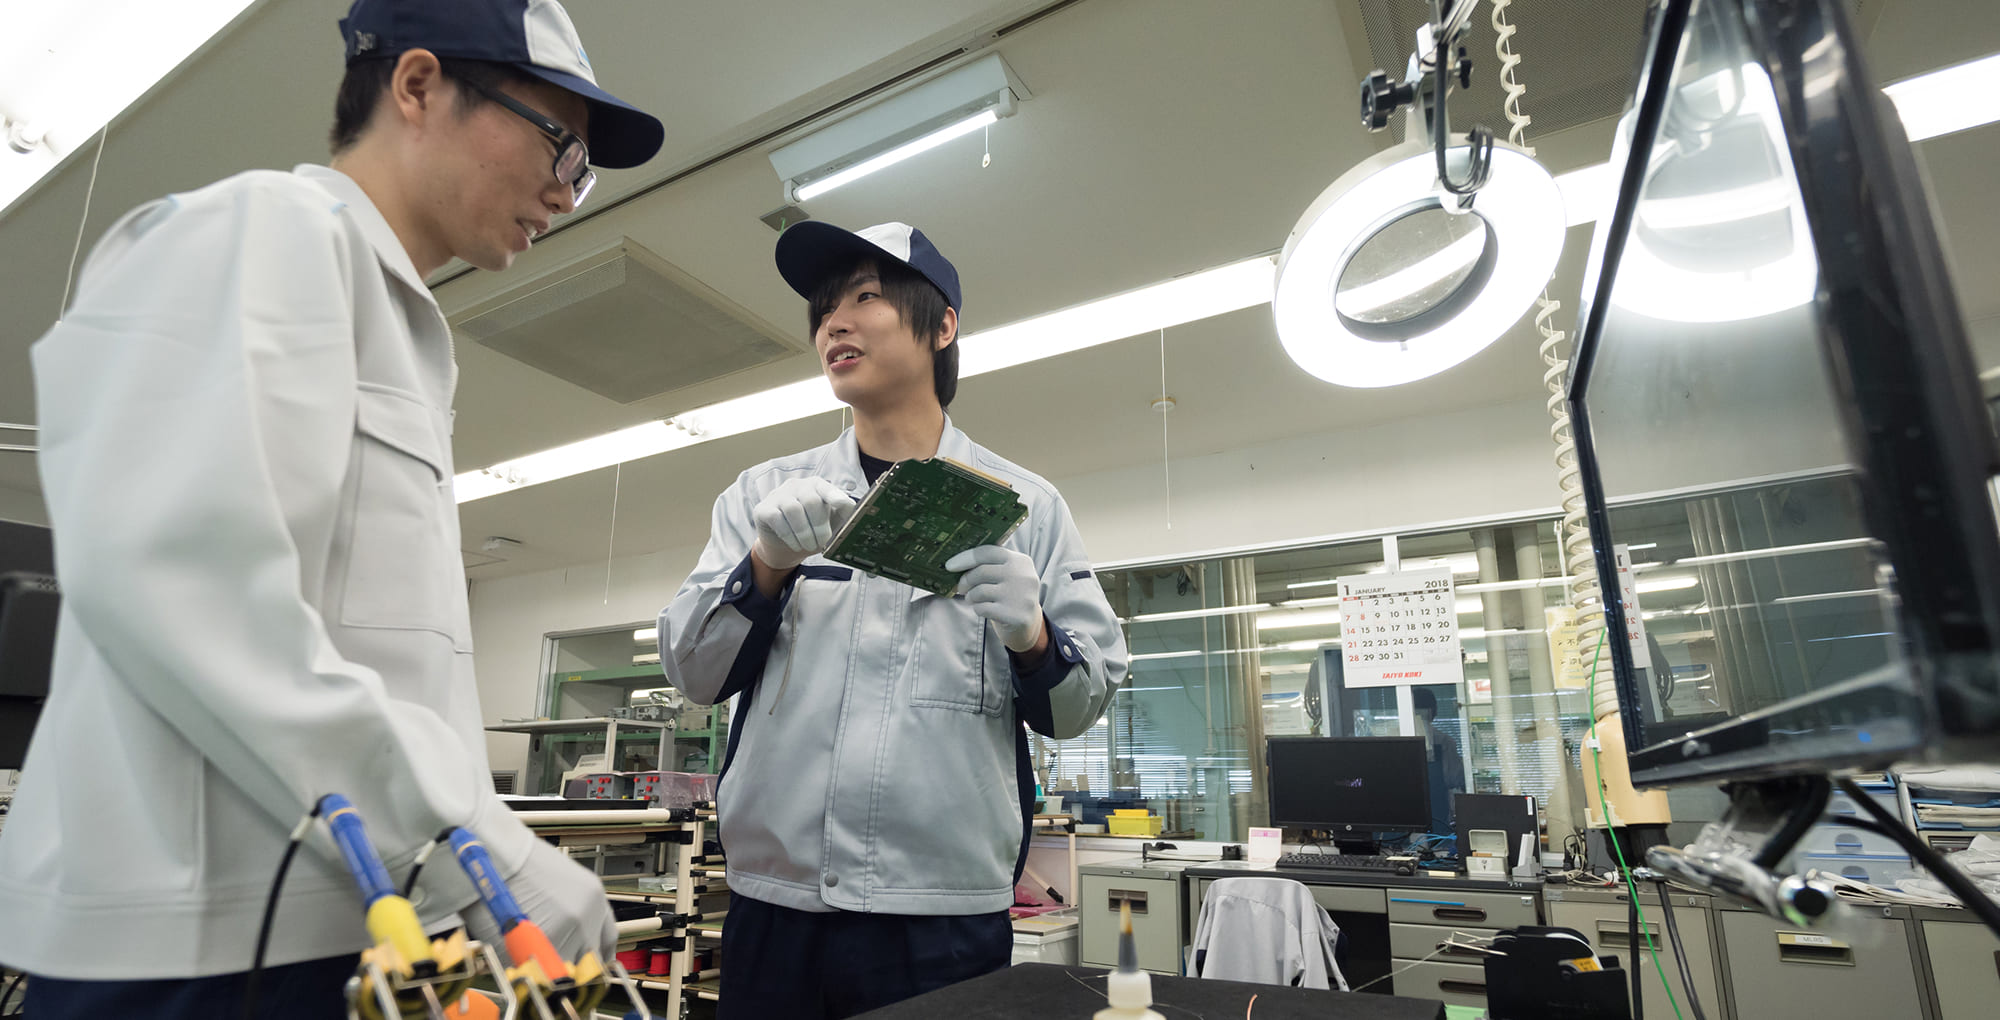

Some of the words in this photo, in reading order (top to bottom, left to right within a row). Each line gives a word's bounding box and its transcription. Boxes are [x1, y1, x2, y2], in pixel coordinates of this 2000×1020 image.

[1343, 585, 1350, 596] 1
[1355, 587, 1386, 595] JANUARY
[1424, 580, 1449, 589] 2018
[1436, 607, 1446, 615] 13
[1438, 621, 1449, 629] 20
[1362, 640, 1373, 648] 22
[1363, 654, 1374, 662] 29
[1378, 653, 1389, 661] 30
[1393, 652, 1403, 660] 31
